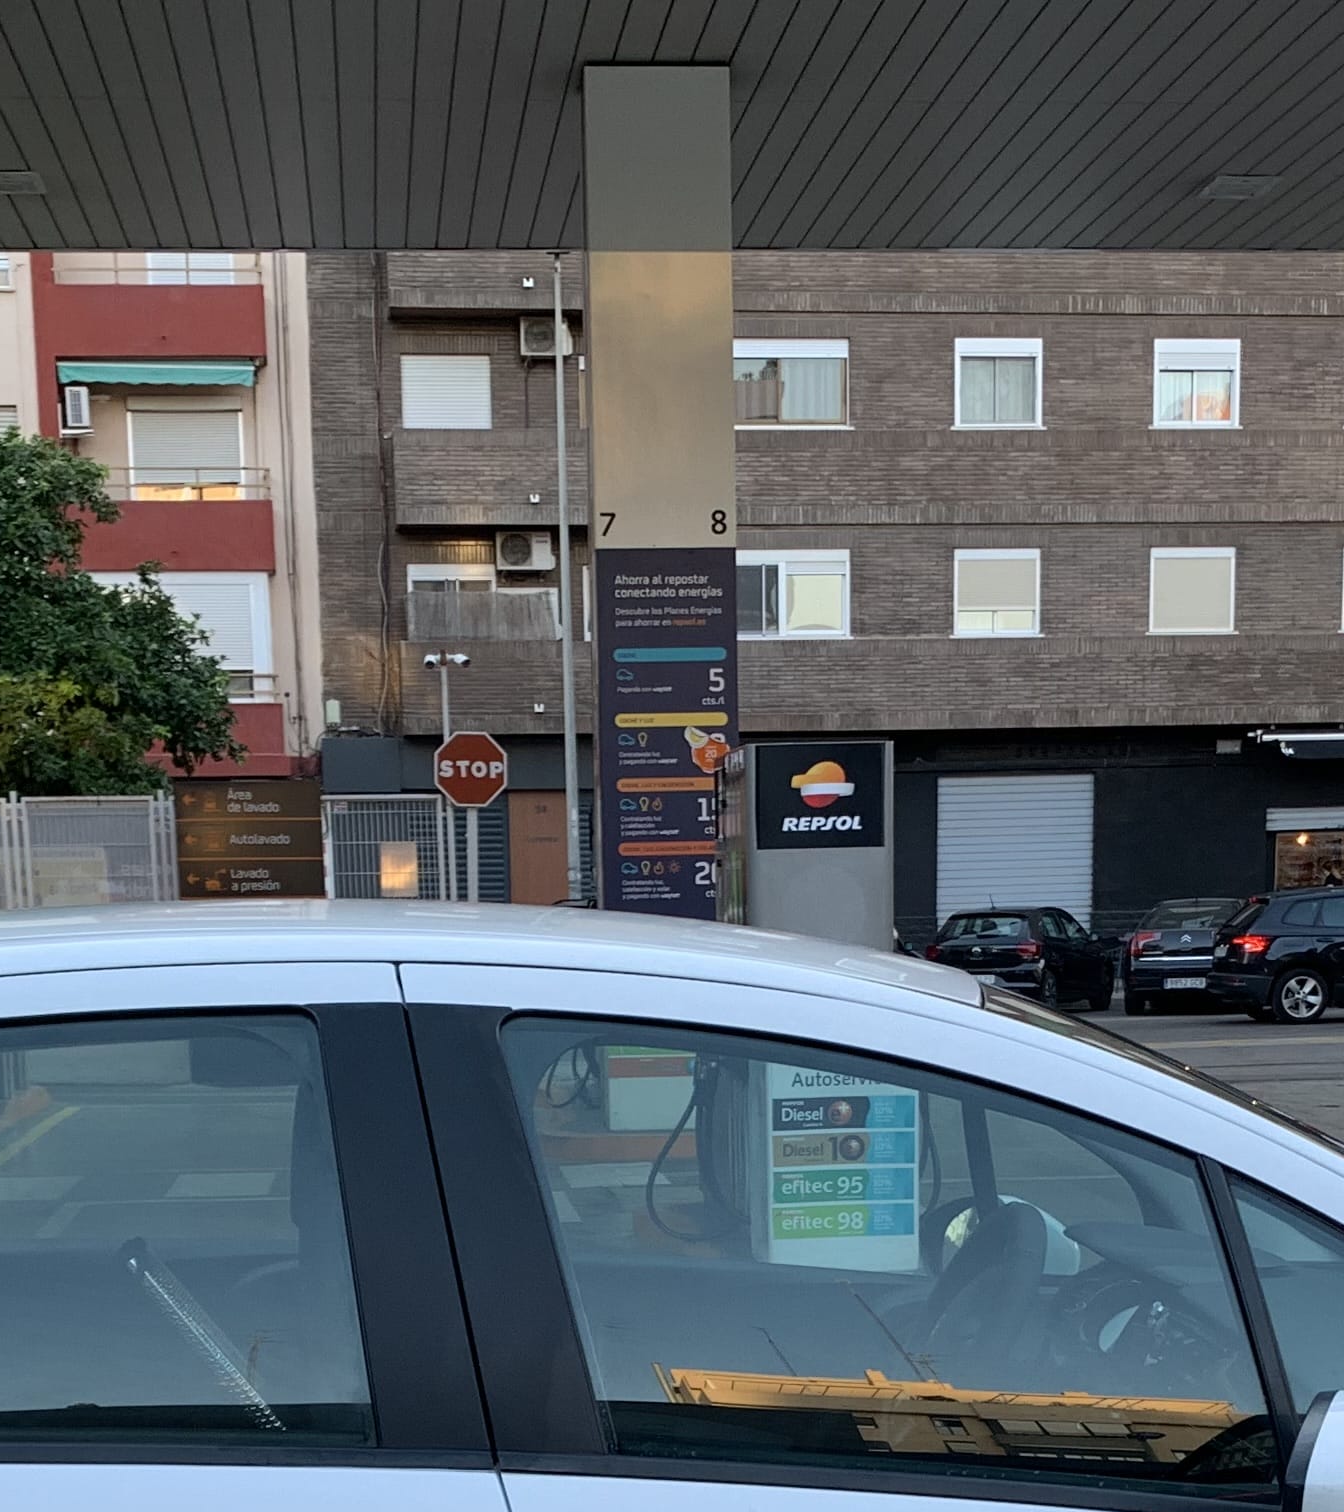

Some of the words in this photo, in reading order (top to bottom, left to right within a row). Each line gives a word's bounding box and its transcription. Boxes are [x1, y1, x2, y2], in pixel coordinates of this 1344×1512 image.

[599, 512, 616, 537] 7
[711, 509, 727, 535] 8
[614, 574, 650, 585] Ahorra
[651, 574, 663, 585] al
[664, 574, 710, 586] repostar
[614, 587, 676, 598] conectando
[678, 585, 723, 599] energías
[708, 668, 725, 692] 5
[438, 759, 504, 779] STOP
[226, 802, 241, 813] de
[243, 802, 281, 813] lavado
[697, 797, 716, 821] 1
[781, 815, 863, 832] REPSOL
[230, 833, 291, 845] Autolavado
[230, 868, 270, 879] Lavado
[695, 861, 716, 886] 2
[231, 882, 238, 891] a
[240, 879, 281, 893] presión
[781, 1106, 824, 1122] Diesel
[782, 1142, 825, 1158] Diesel
[828, 1134, 866, 1161] 10
[781, 1179, 834, 1196] efitec
[837, 1176, 864, 1195] 95
[781, 1214, 834, 1231] efitec
[837, 1211, 865, 1231] 98
